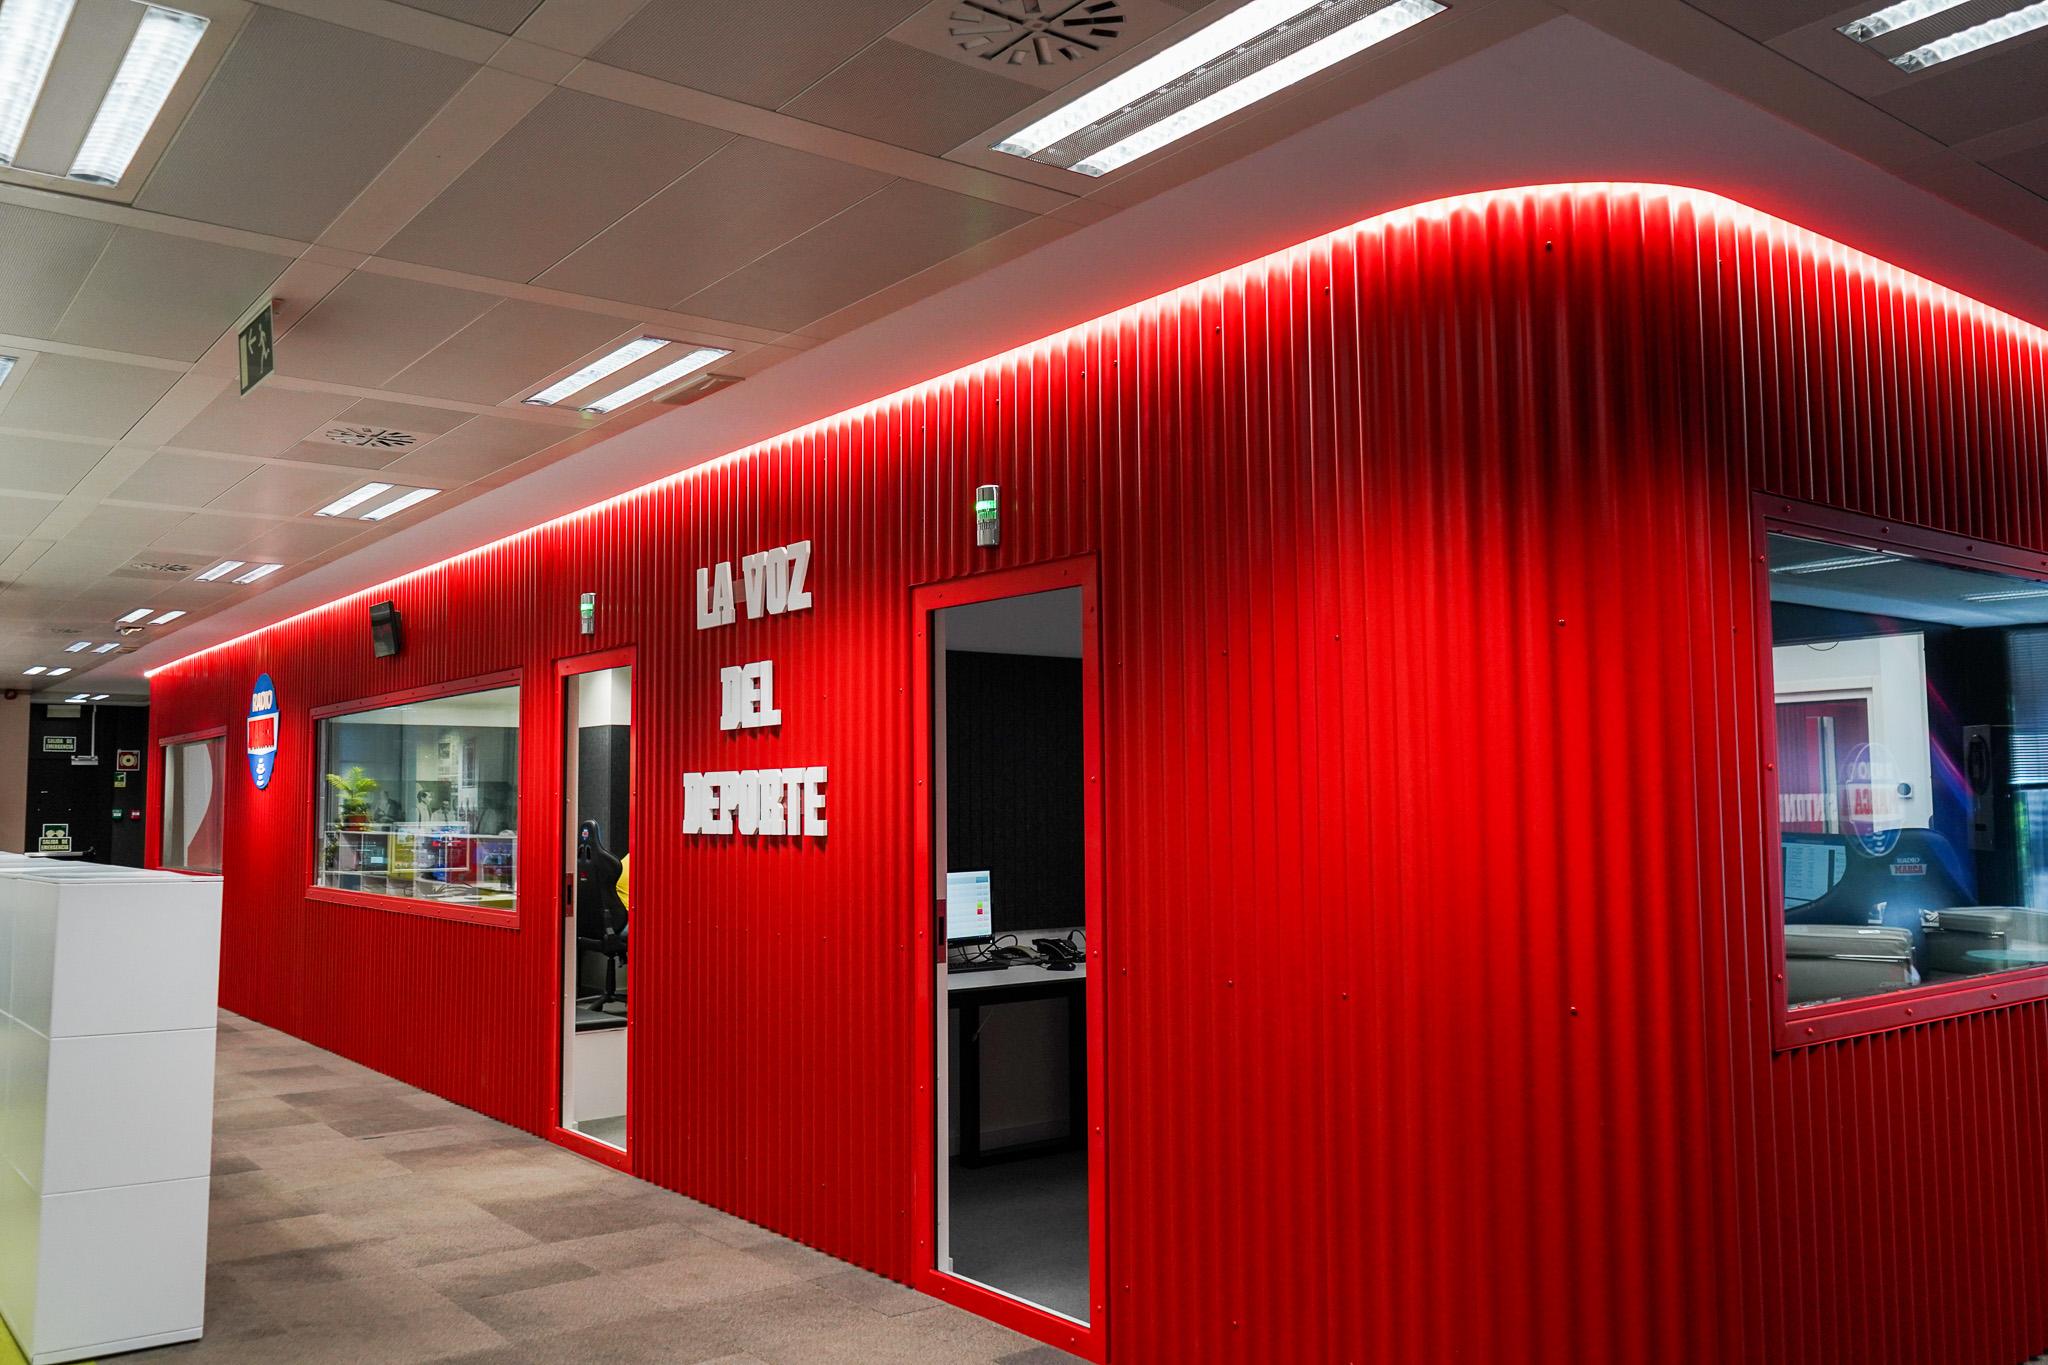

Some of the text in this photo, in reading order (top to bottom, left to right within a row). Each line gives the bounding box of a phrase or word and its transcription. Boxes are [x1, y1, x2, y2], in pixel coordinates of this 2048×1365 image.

[697, 540, 812, 630] LA VOZ
[252, 690, 273, 712] RADIO
[720, 660, 782, 731] DEL
[682, 766, 828, 836] DEPORTE
